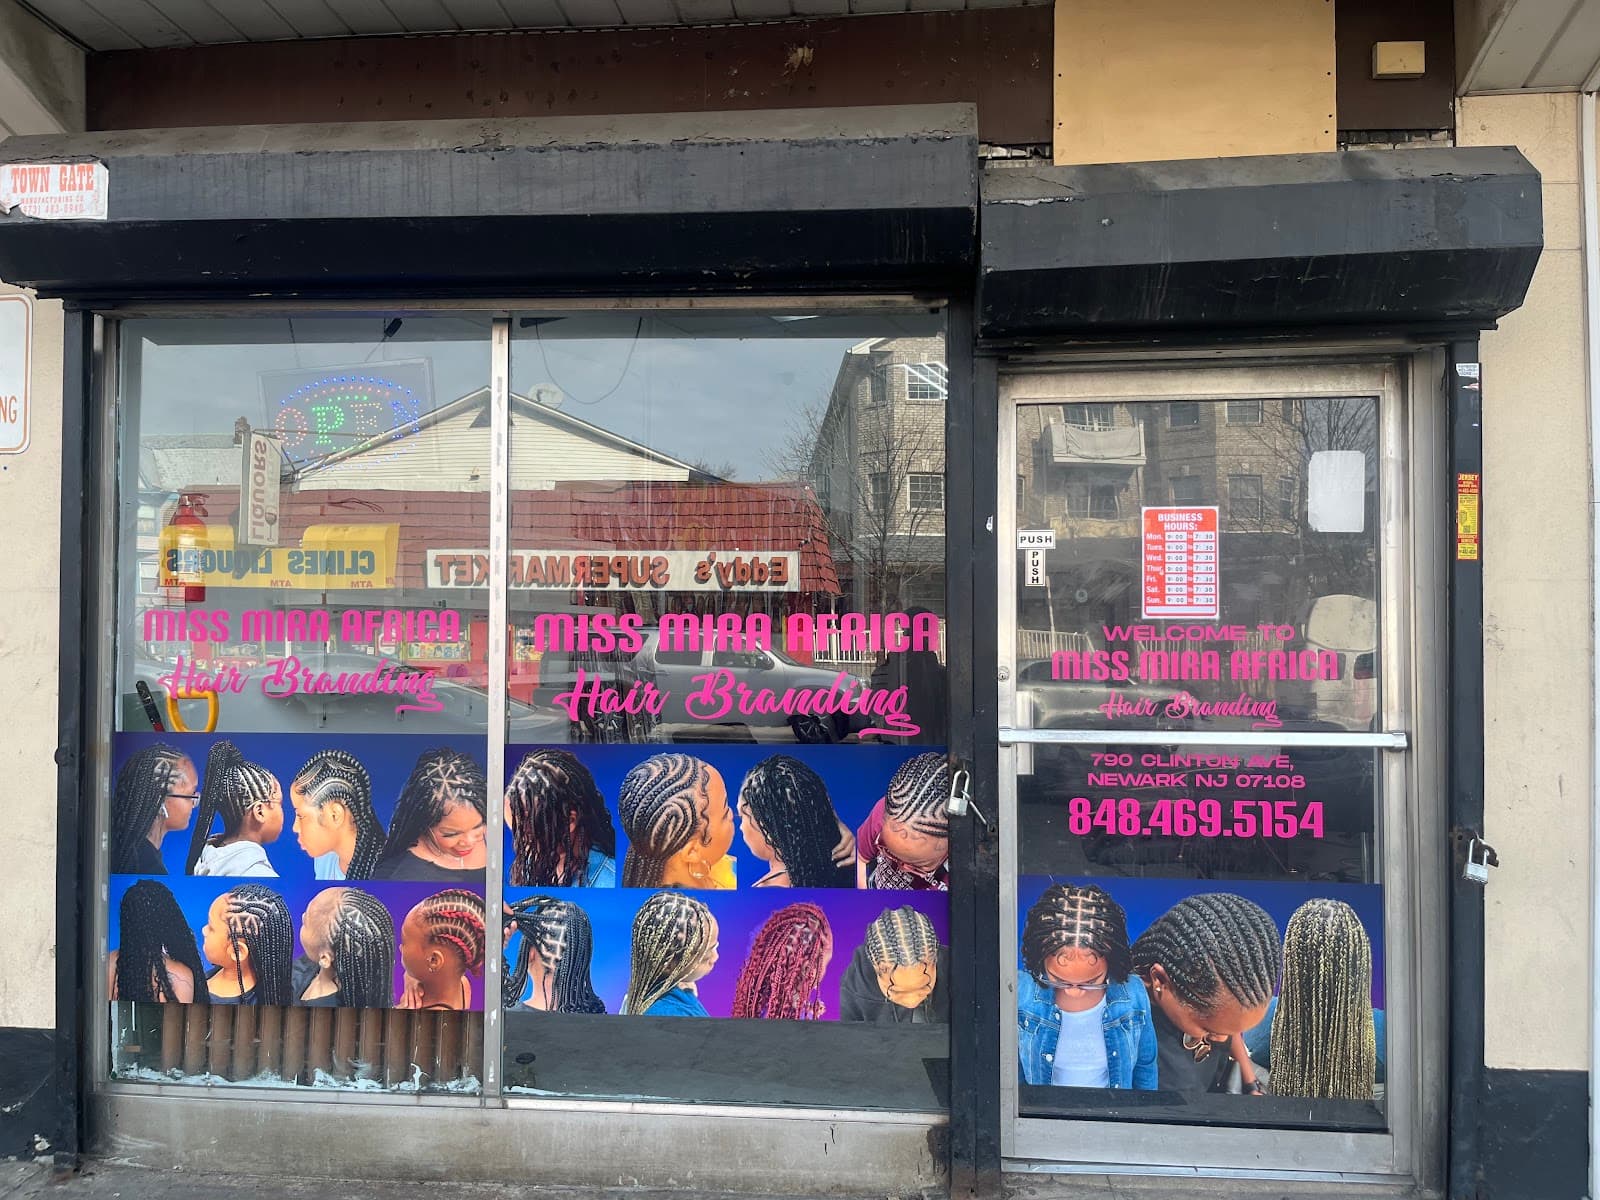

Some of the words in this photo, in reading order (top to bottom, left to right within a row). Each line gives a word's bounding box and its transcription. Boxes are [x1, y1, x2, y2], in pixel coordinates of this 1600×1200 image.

[11, 166, 50, 193] TOWN
[59, 164, 94, 192] GATE
[1158, 512, 1203, 522] BUSINESS
[1164, 522, 1198, 531] HOURS:
[1020, 535, 1053, 543] PUSH
[1031, 551, 1039, 584] PUSH
[143, 610, 231, 642] MISS
[241, 610, 330, 642] MIRA
[341, 610, 460, 643] AFRICA
[534, 613, 644, 653] MISS
[658, 613, 773, 653] MIRA
[787, 612, 940, 654] AFRICA
[1103, 625, 1246, 641] WELCOME
[1257, 625, 1295, 641] TO
[1051, 650, 1130, 681] MISS
[1139, 650, 1220, 681] MIRA
[1230, 649, 1339, 681] AFRICA
[158, 655, 249, 700] Hair
[261, 655, 444, 714] Branding
[552, 667, 670, 722] Hair
[684, 668, 922, 739] Branding
[1099, 690, 1159, 720] Hair
[1164, 690, 1283, 729] Branding
[1090, 753, 1134, 767] 790
[1140, 753, 1241, 768] CLINTON
[1247, 754, 1294, 771] AVE,
[1087, 773, 1187, 787] NEWARK
[1194, 774, 1228, 787] NJ
[1235, 774, 1306, 789] 07108
[1068, 797, 1324, 838] 848.469.5154
